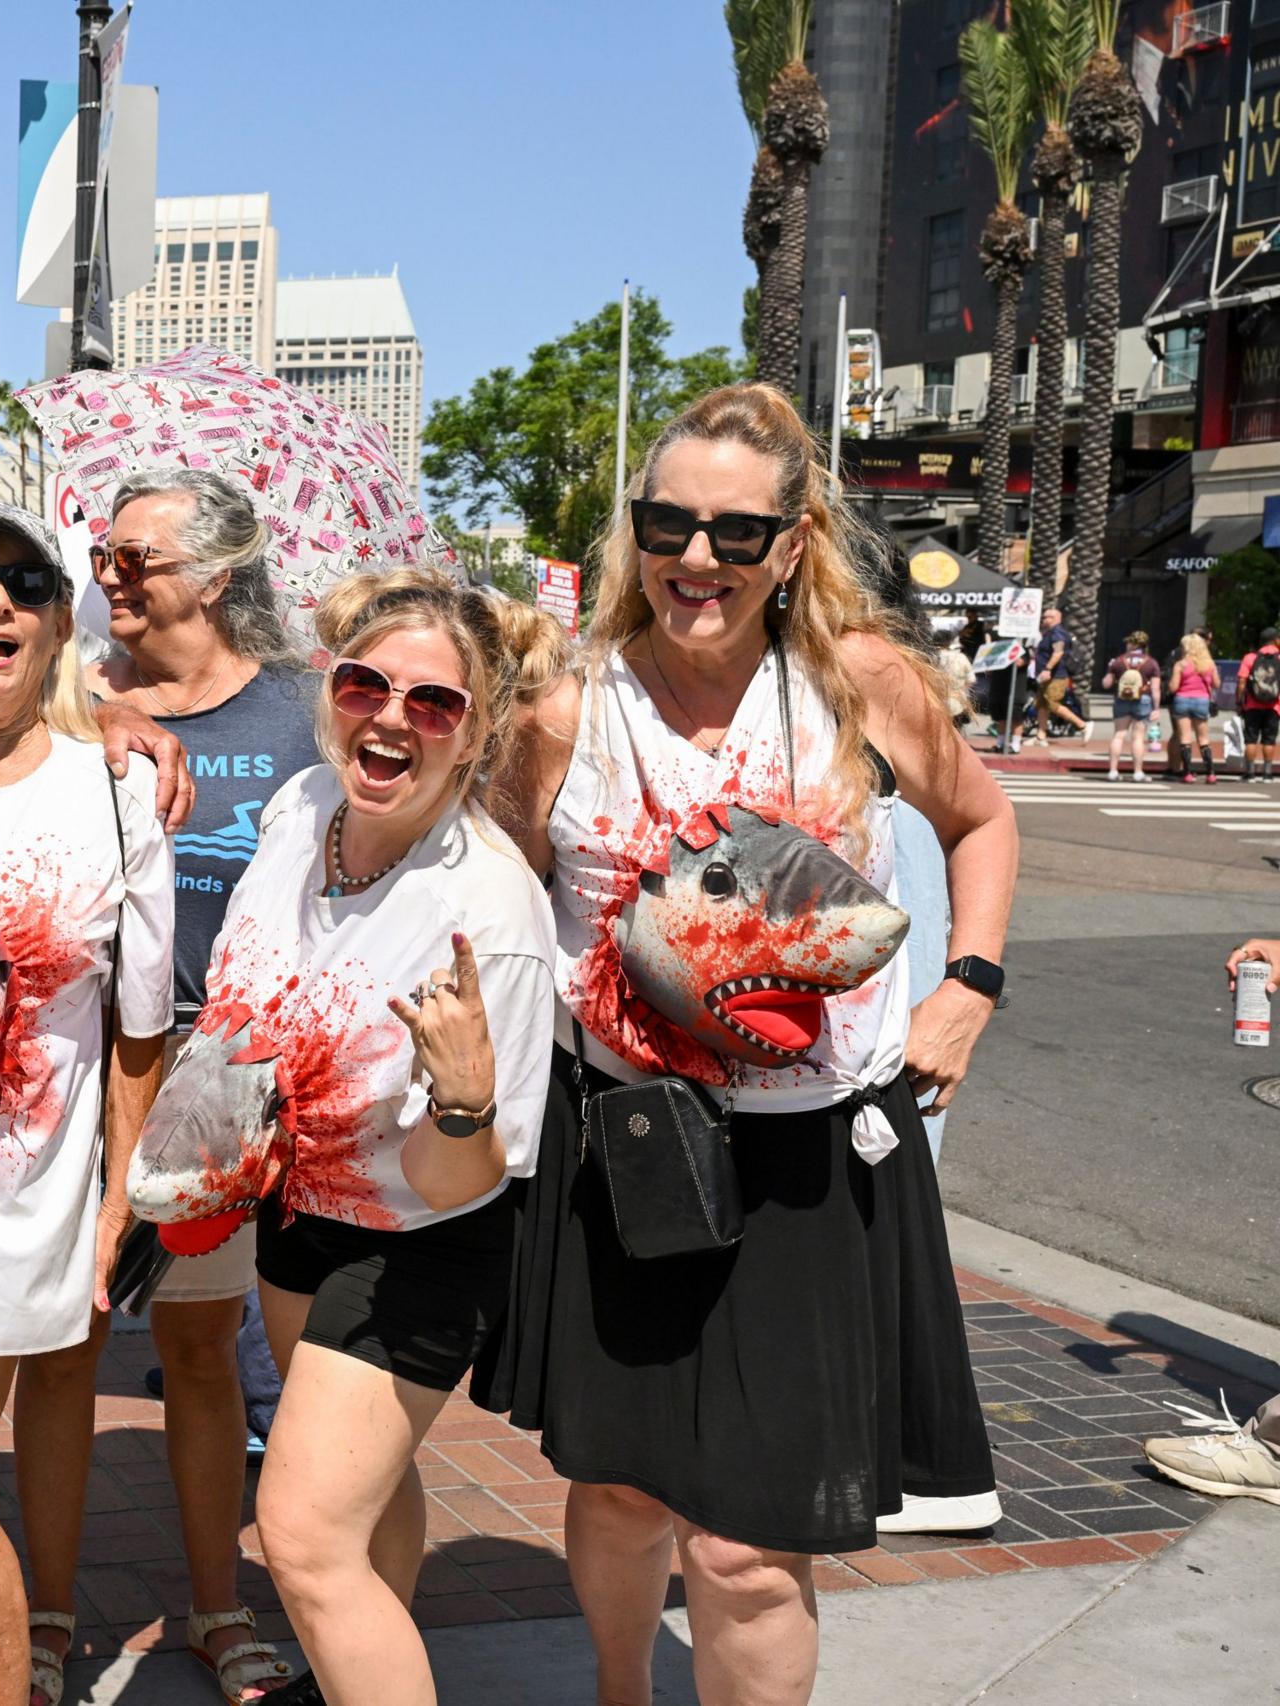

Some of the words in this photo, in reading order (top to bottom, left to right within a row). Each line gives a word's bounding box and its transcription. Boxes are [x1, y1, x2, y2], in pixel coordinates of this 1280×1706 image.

[913, 592, 953, 605] EGO
[955, 592, 1003, 605] POLIC
[186, 754, 274, 778] MES
